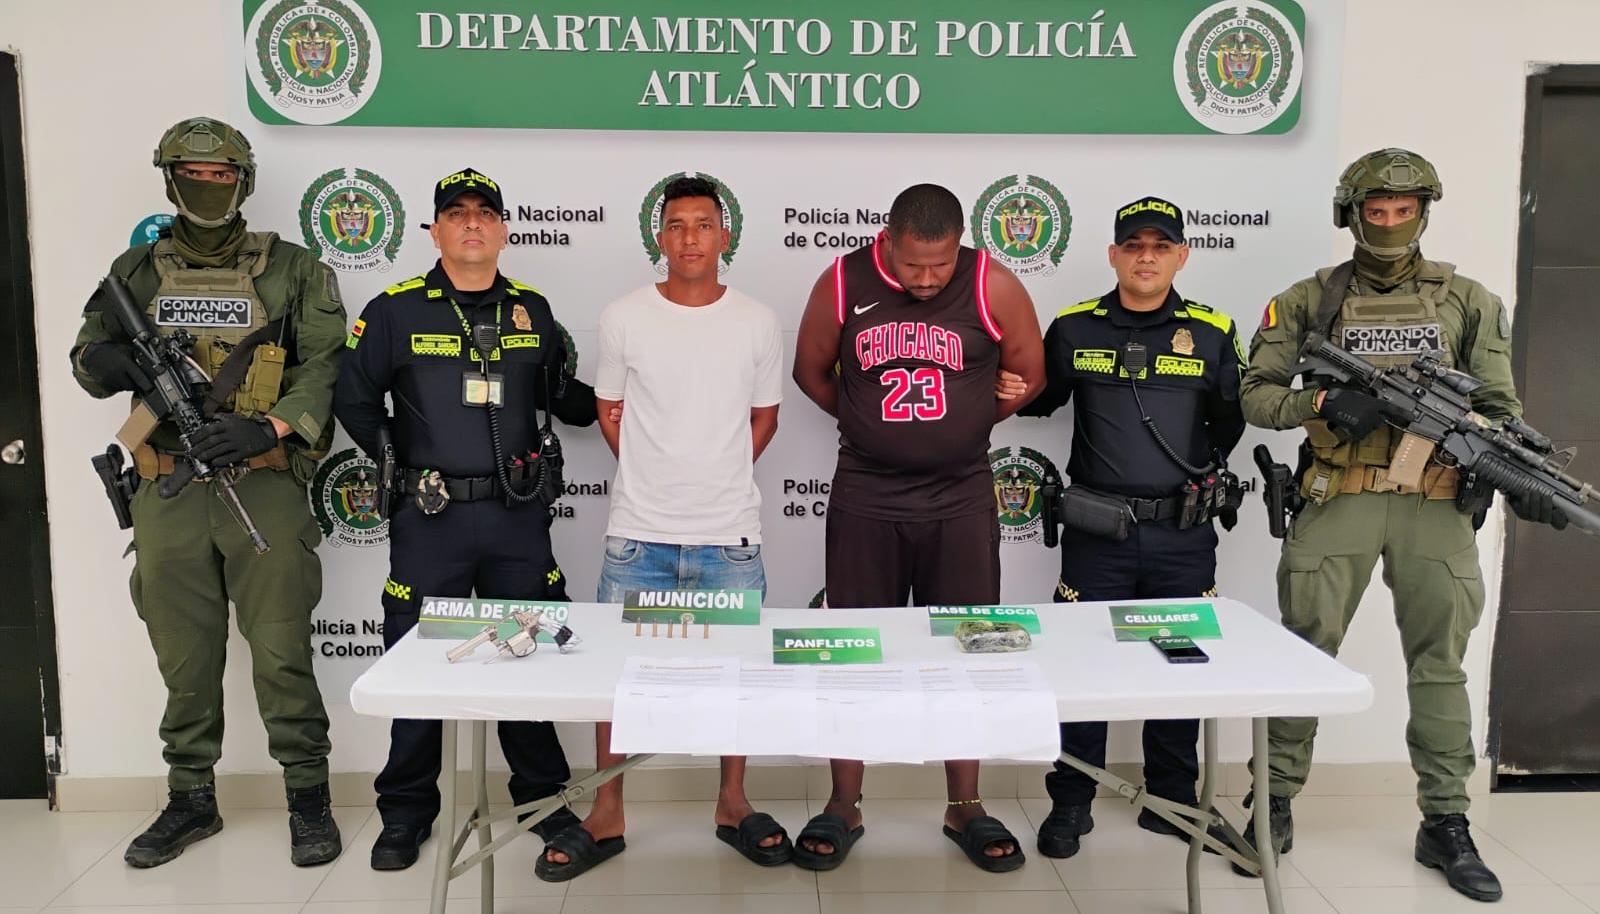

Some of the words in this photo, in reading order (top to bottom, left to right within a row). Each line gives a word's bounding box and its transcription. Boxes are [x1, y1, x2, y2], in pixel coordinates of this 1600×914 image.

[328, 12, 357, 57] COLOMBIA
[416, 12, 831, 55] DEPARTAMENTO
[850, 18, 917, 56] DE
[934, 9, 1137, 58] POLICÍA
[1257, 25, 1280, 69] COLOMBIA
[316, 67, 354, 94] NACIONAL
[638, 59, 921, 110] ATLÁNTICO
[316, 93, 345, 105] PATRIA
[1238, 79, 1276, 104] NACIONAL
[1237, 103, 1265, 115] PATRIA
[366, 185, 392, 226] COLOMBIA
[1036, 190, 1060, 232] COLOMBIA
[518, 206, 604, 222] Nacional
[784, 208, 849, 224] Policía
[1187, 210, 1269, 226] Nacional
[354, 236, 389, 260] NACIONAL
[784, 232, 808, 248] de
[814, 232, 875, 248] Colom
[1020, 241, 1056, 265] NACIONAL
[161, 299, 247, 314] COMANDO
[166, 311, 240, 324] JUNGLA
[1345, 327, 1437, 342] COMANDO
[856, 322, 963, 371] CHICAGO
[1352, 339, 1430, 352] JUNGLA
[880, 368, 947, 421] 23
[783, 479, 830, 495] Polic
[783, 501, 806, 517] de
[638, 589, 744, 609] MUNICIÓN
[423, 601, 475, 618] ARMA
[480, 604, 504, 619] DE
[930, 606, 968, 615] BASE
[972, 606, 991, 615] DE
[995, 607, 1036, 616] COCA
[1124, 613, 1199, 624] CELULARES
[321, 641, 383, 657] Colom
[784, 638, 876, 649] PANFLETOS
